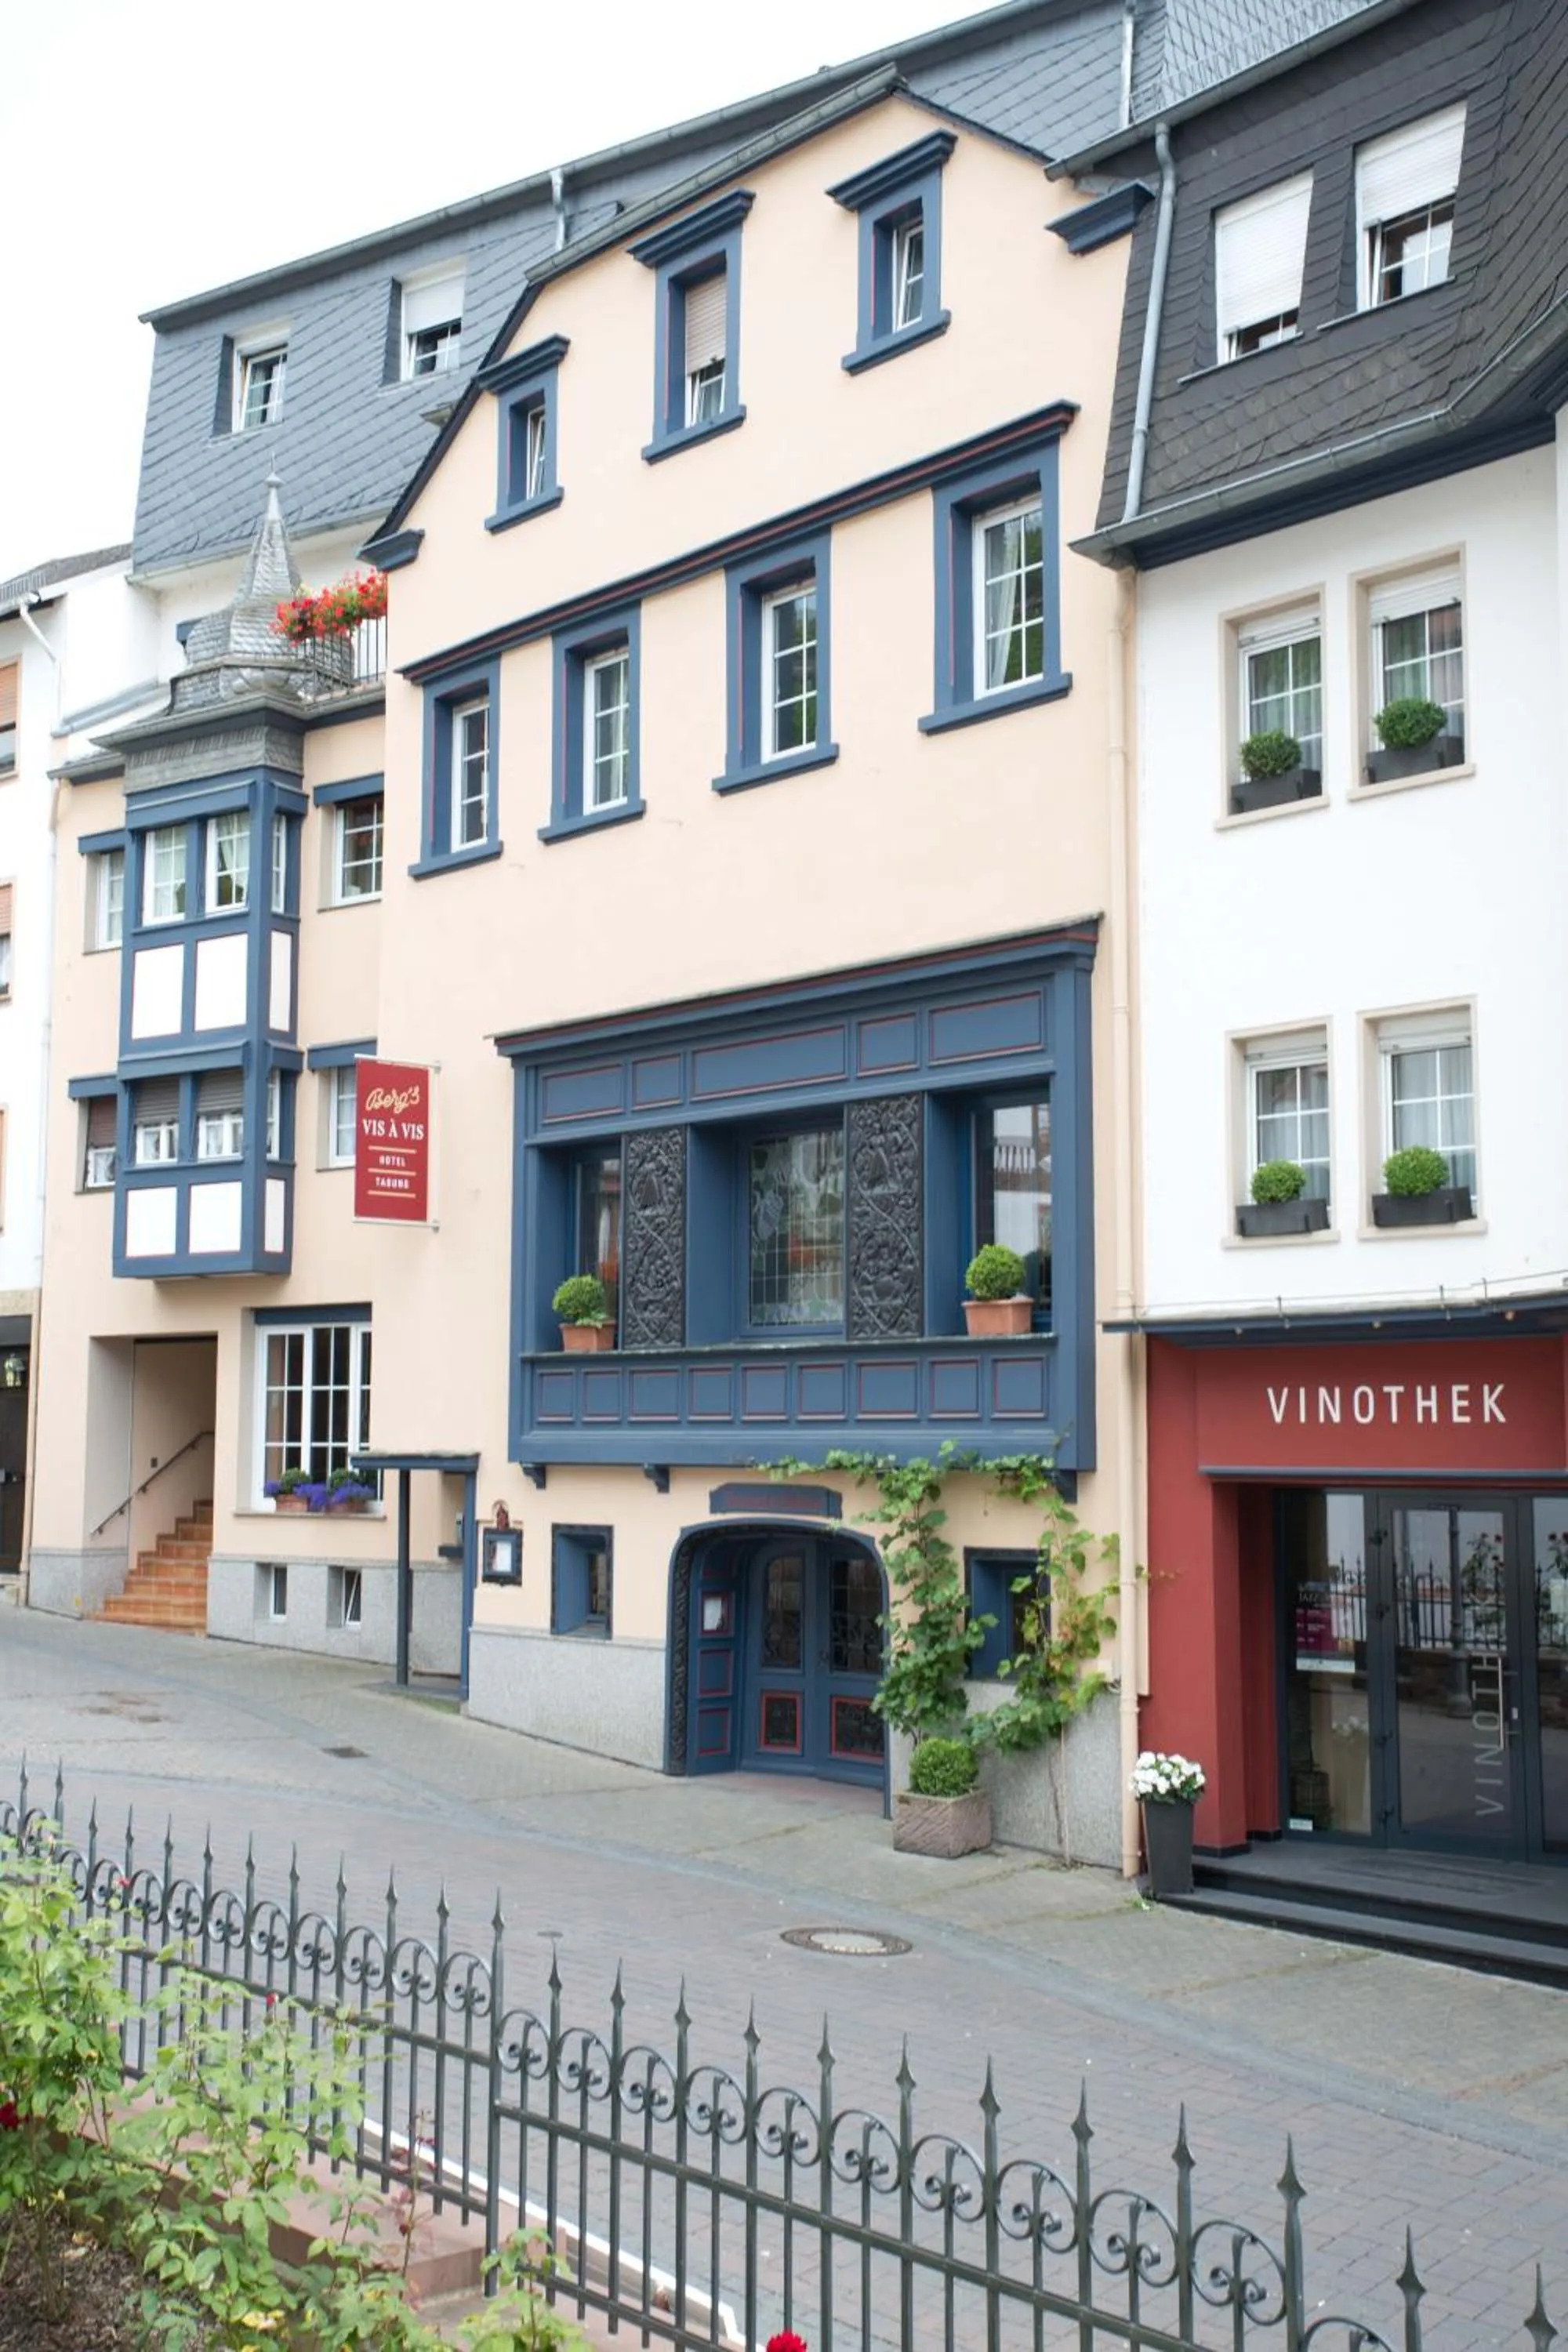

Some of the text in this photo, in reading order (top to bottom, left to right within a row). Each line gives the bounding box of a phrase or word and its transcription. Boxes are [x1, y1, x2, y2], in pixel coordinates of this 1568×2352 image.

[365, 1085, 420, 1114] Berg's
[362, 1118, 424, 1141] VIS À VIS
[379, 1154, 406, 1167] HOTEL
[1267, 1384, 1506, 1424] VINOTHEK
